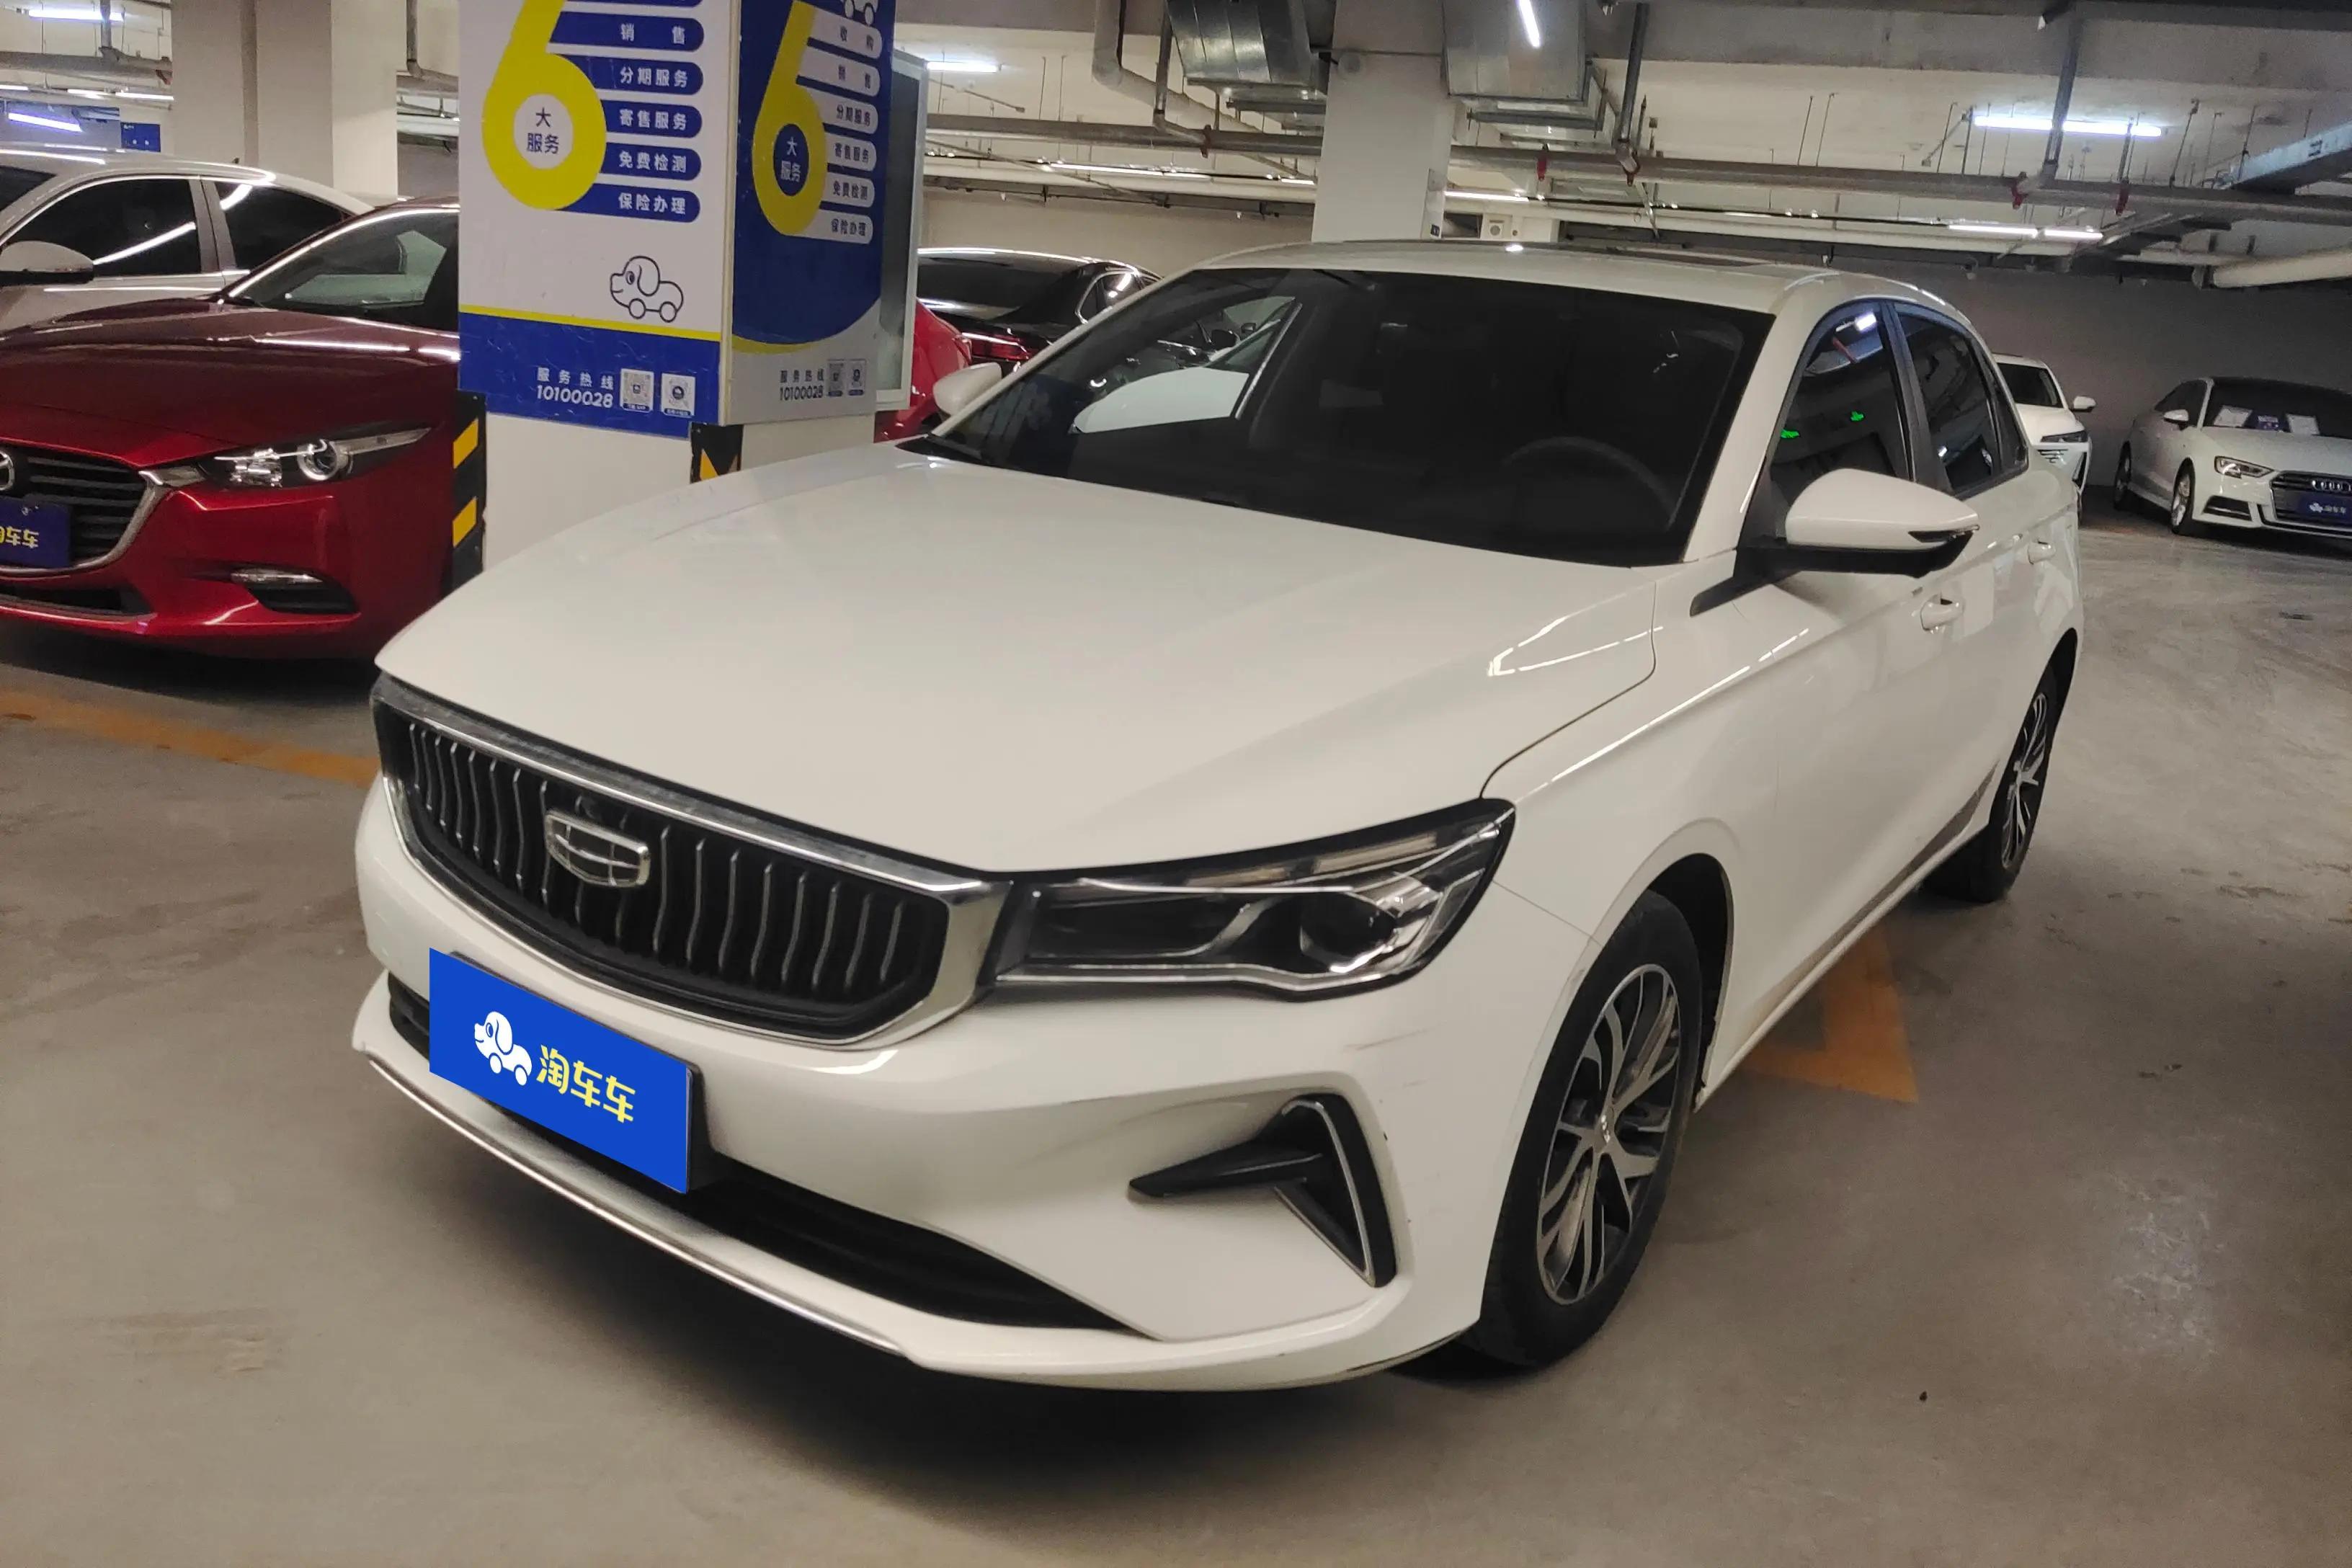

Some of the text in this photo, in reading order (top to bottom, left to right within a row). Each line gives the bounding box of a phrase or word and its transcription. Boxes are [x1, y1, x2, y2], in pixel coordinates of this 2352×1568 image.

[620, 23, 685, 45] 销售
[620, 66, 687, 88] 分期服务
[535, 106, 552, 128] 大
[619, 109, 687, 131] 寄售服务
[527, 133, 559, 154] 服务
[786, 136, 798, 156] 大
[618, 151, 687, 174] 免费检测
[780, 160, 801, 183] 服务
[618, 192, 686, 215] 保险办理
[537, 367, 614, 390] 服务热线
[537, 385, 613, 409] 10100028
